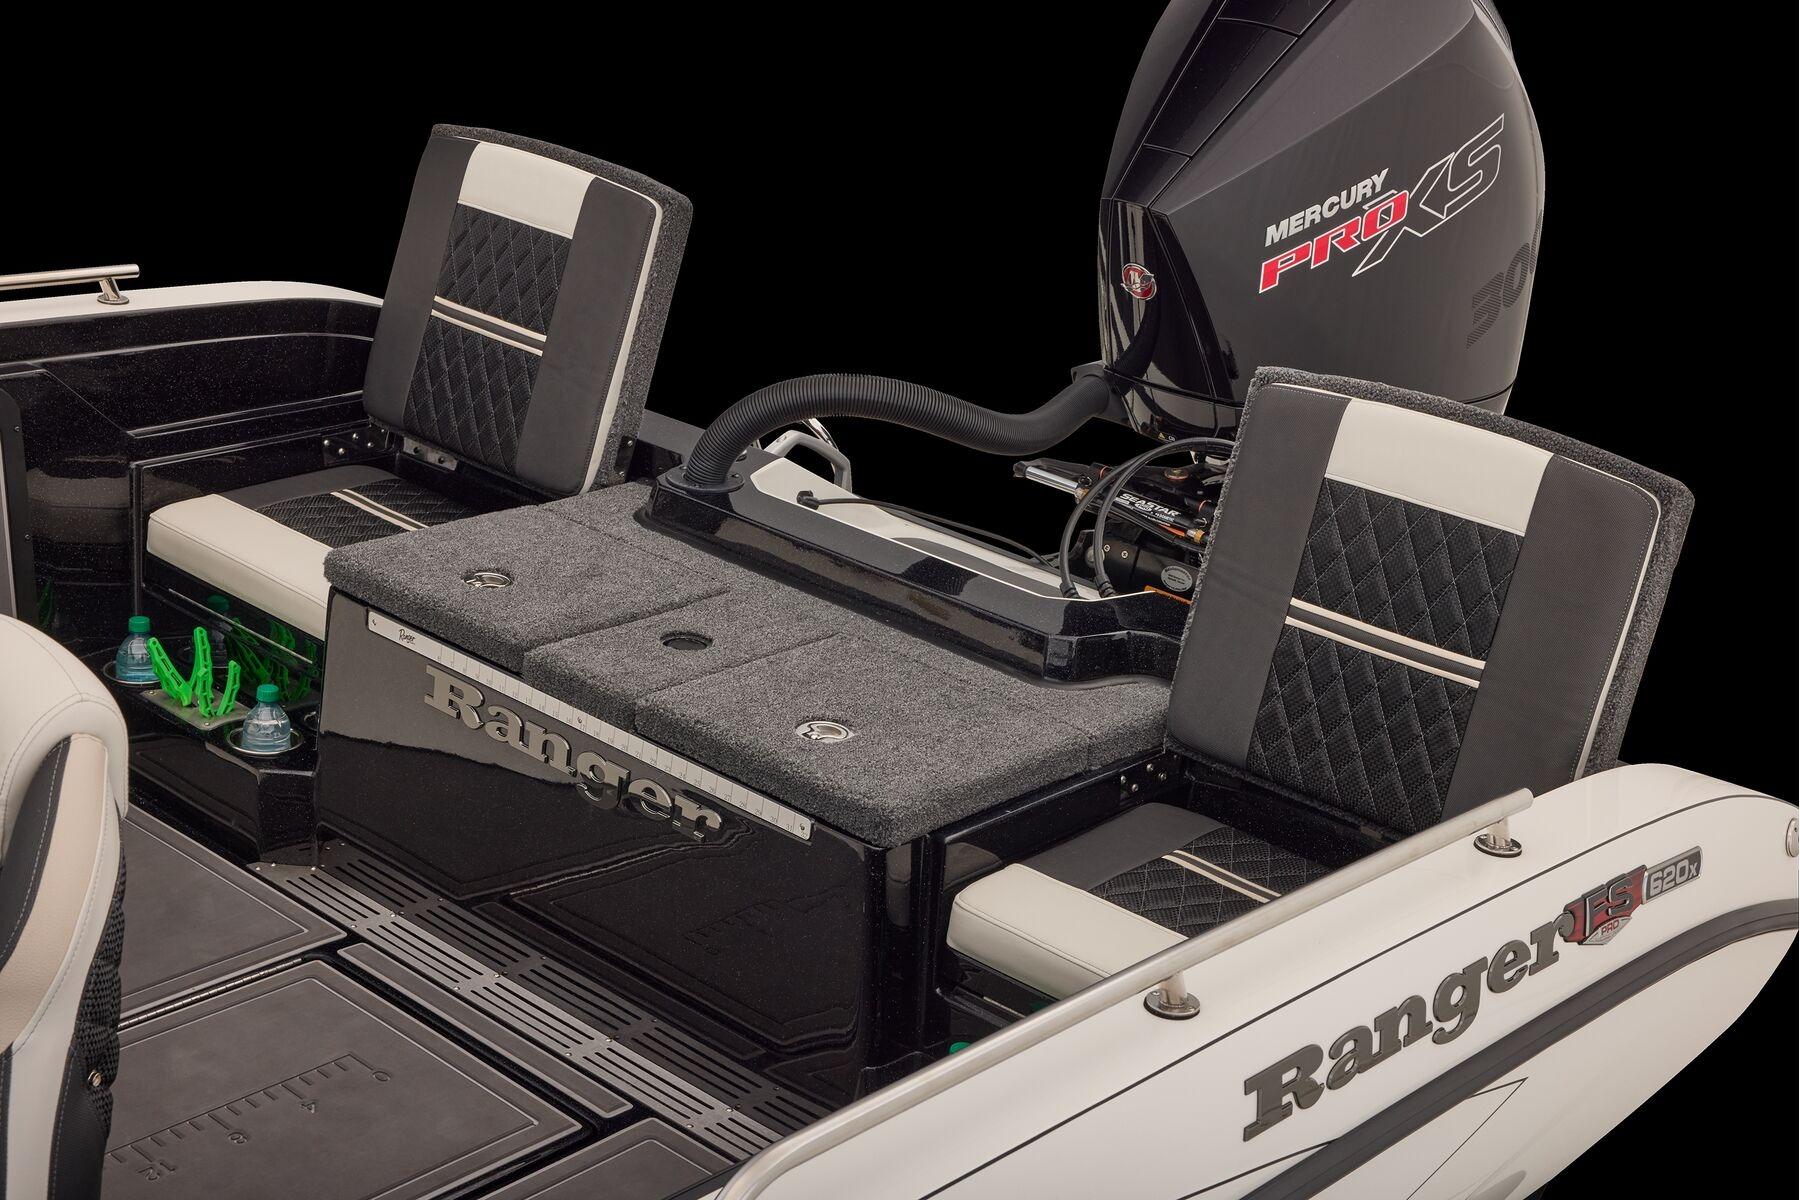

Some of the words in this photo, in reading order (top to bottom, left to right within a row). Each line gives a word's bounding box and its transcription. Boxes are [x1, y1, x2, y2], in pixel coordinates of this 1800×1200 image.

[1265, 168, 1389, 247] MERCURY
[1259, 190, 1409, 293] PRO
[1120, 493, 1181, 517] SEASTAR
[423, 664, 722, 839] Ranger
[1650, 858, 1698, 897] 620x
[1584, 873, 1635, 937] FS
[1601, 919, 1620, 936] PRO
[1243, 910, 1575, 1141] Ranger
[301, 1101, 317, 1114] 4
[228, 1131, 248, 1145] 8
[138, 1160, 177, 1182] 12
